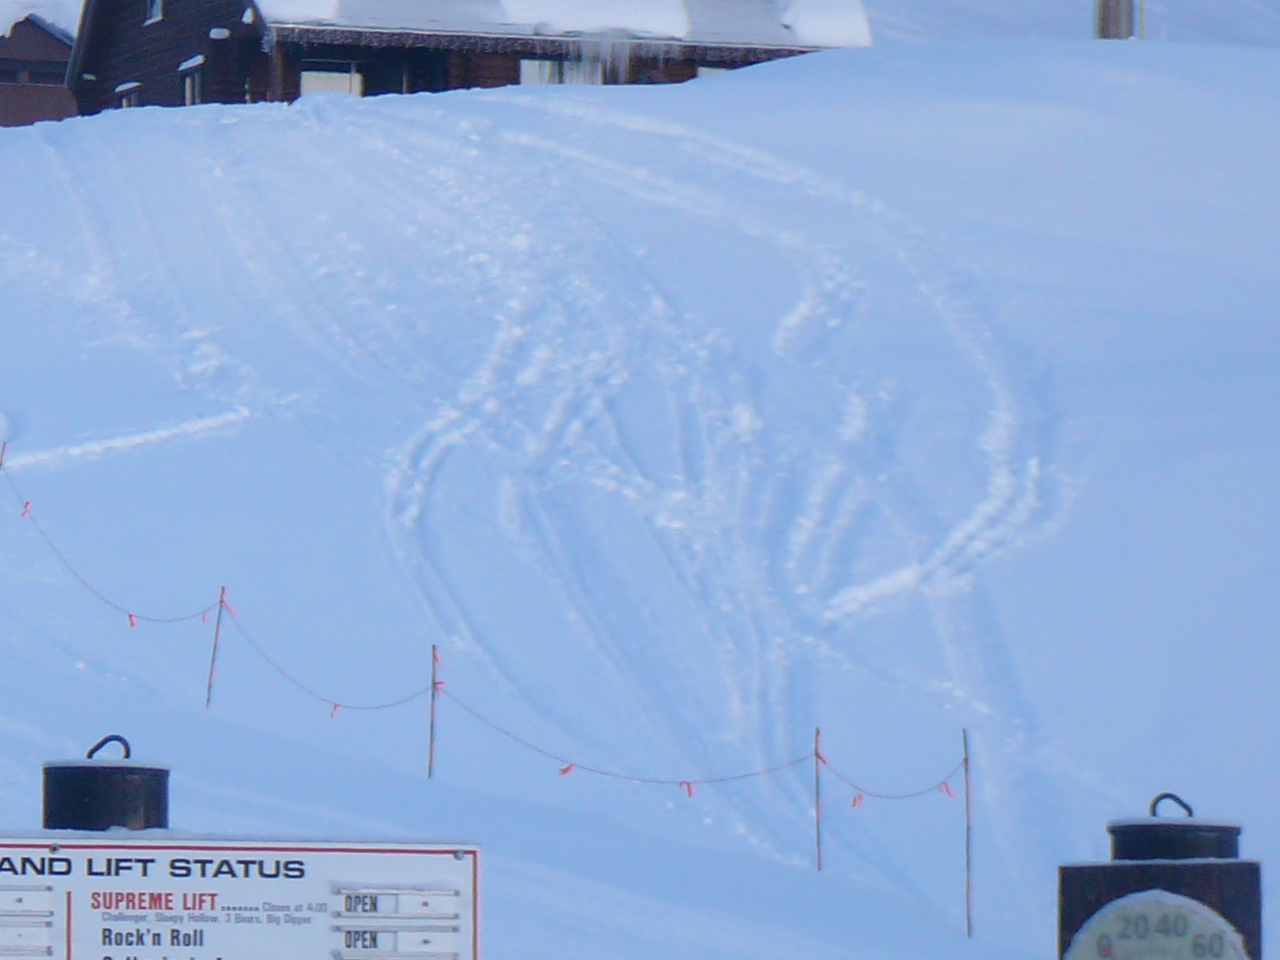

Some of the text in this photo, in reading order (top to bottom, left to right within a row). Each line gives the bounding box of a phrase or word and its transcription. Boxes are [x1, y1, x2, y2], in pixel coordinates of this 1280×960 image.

[86, 858, 155, 877] LIFT
[169, 860, 305, 879] STATUS
[90, 892, 173, 910] SUPREME
[183, 893, 218, 911] LIFT
[345, 895, 377, 912] OPEN
[1119, 915, 1148, 939] 20
[1154, 914, 1188, 937] 40
[101, 929, 204, 947] Rock'n Roll
[345, 931, 377, 949] OPEN
[1097, 935, 1111, 959] 0
[1192, 934, 1223, 958] 60
